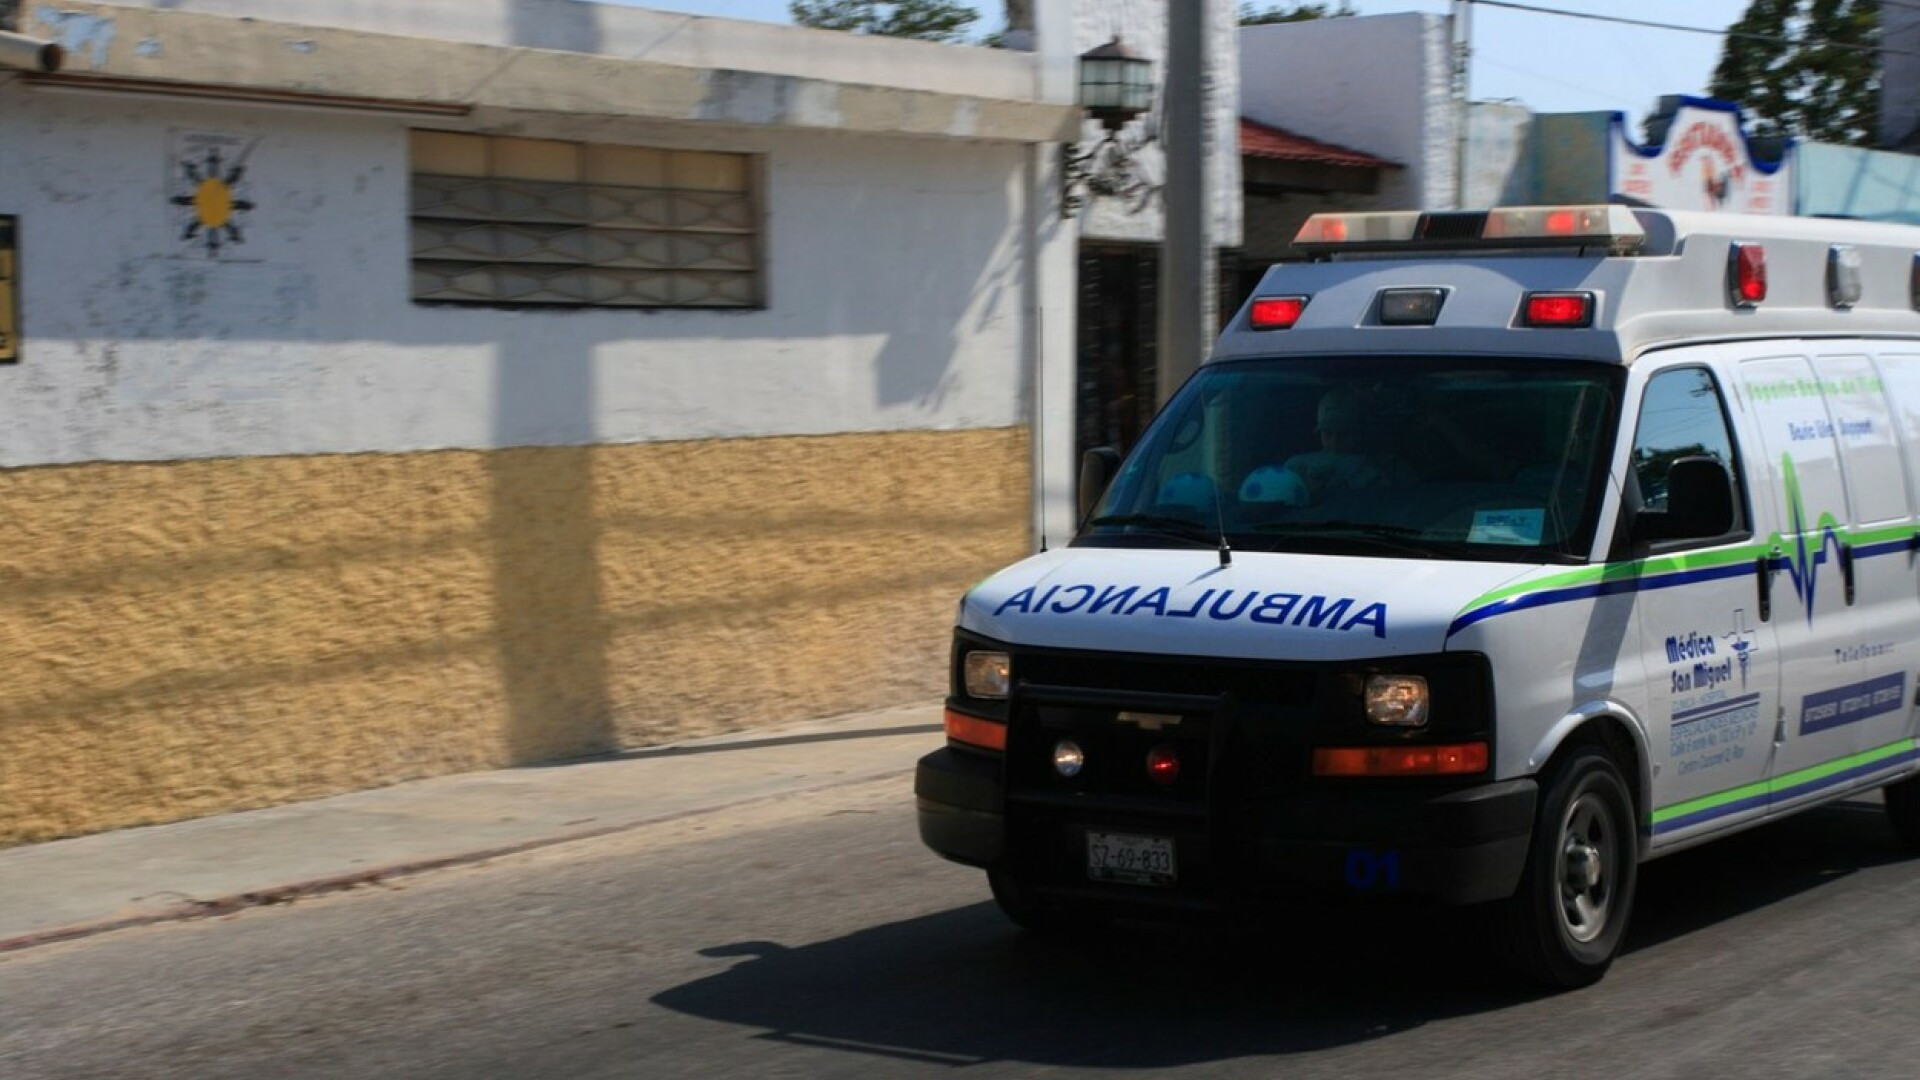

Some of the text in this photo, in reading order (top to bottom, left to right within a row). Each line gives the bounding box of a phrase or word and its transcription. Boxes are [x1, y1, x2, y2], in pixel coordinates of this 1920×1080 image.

[1665, 631, 1715, 664] Médica
[1671, 656, 1731, 693] San Miguel
[1345, 848, 1400, 892] 01
